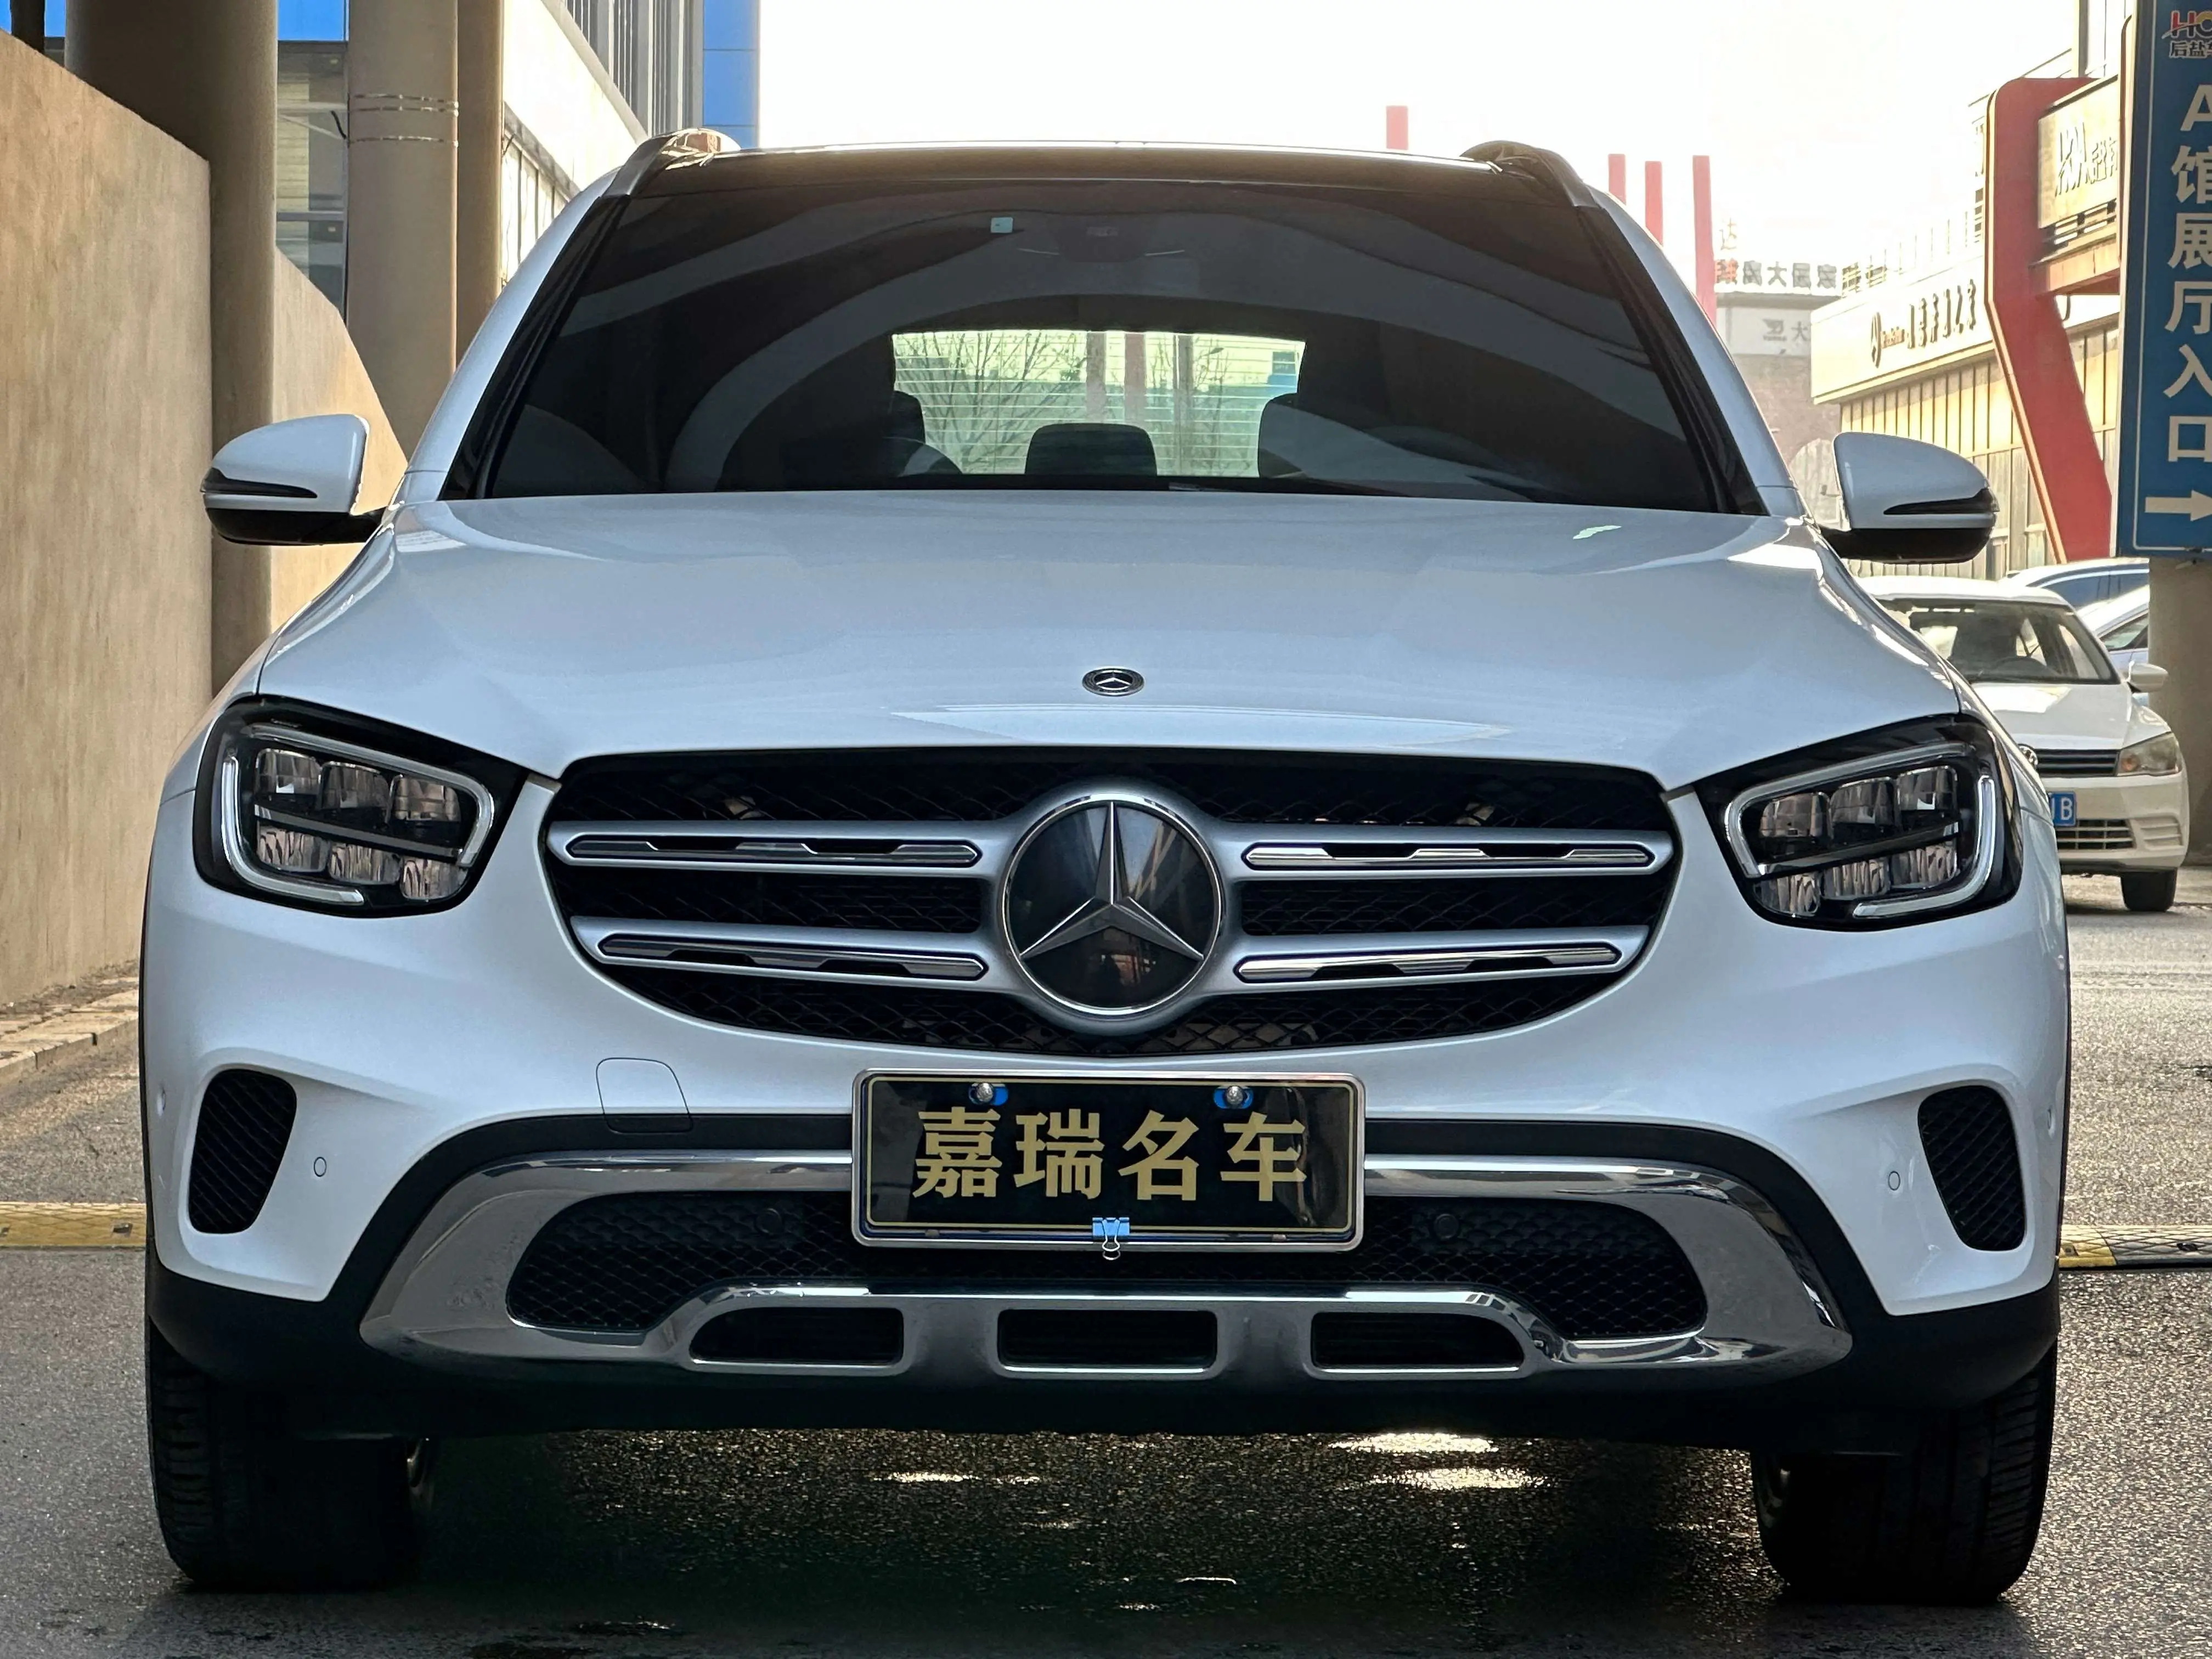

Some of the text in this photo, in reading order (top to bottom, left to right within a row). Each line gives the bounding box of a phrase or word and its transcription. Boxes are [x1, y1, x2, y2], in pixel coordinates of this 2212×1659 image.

[2169, 40, 2212, 58] 后盐
[2163, 84, 2212, 462] A馆展厅入口
[912, 1106, 1307, 1202] 嘉瑞名车
